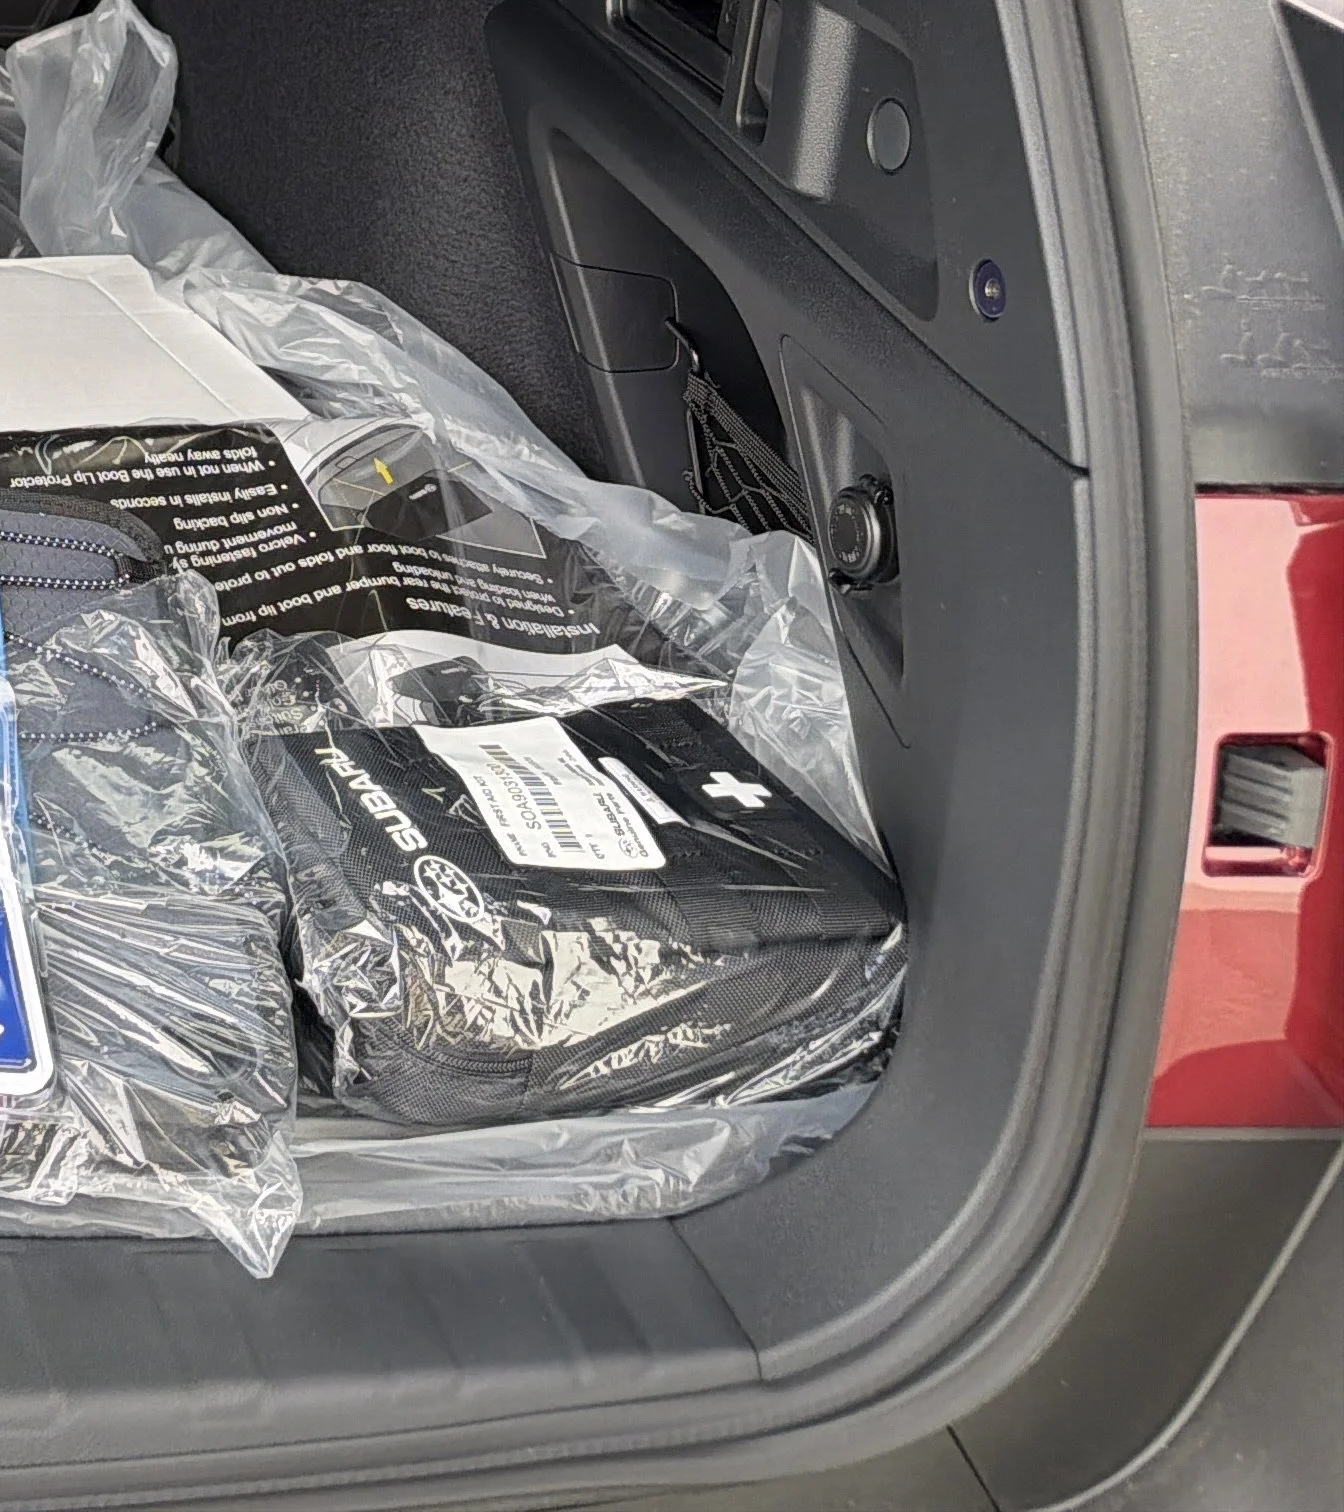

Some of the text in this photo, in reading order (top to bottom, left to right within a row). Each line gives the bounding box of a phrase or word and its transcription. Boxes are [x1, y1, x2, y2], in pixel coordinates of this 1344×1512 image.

[144, 445, 259, 464] folds away neatly
[10, 460, 265, 488] When not in use the Boot Lip Protector
[109, 483, 278, 508] Easily installs in seconds
[173, 503, 290, 531] Non slip backing
[224, 521, 298, 546] movement
[260, 533, 307, 553] Velcro
[176, 540, 223, 555] during
[336, 543, 365, 559] and
[367, 543, 399, 556] floor
[401, 545, 426, 558] boot
[429, 549, 442, 562] to
[190, 548, 258, 568] fastening
[299, 551, 335, 569] folds
[441, 553, 491, 573] attaches
[254, 570, 270, 583] to
[271, 562, 297, 578] out
[391, 562, 454, 582] unloading
[492, 563, 545, 585] Securely
[477, 579, 523, 597] loading
[523, 589, 556, 604] when
[221, 575, 565, 627] Designed to protect the rear bumper and boot lip from
[405, 596, 601, 638] Installation & Features
[473, 775, 487, 788] KIT
[314, 748, 428, 851] SUBARU
[482, 788, 497, 803] AID
[606, 792, 625, 815] Parts
[489, 803, 510, 827] FIRST
[593, 792, 625, 836] SUBARU
[623, 817, 649, 858] Genuine
